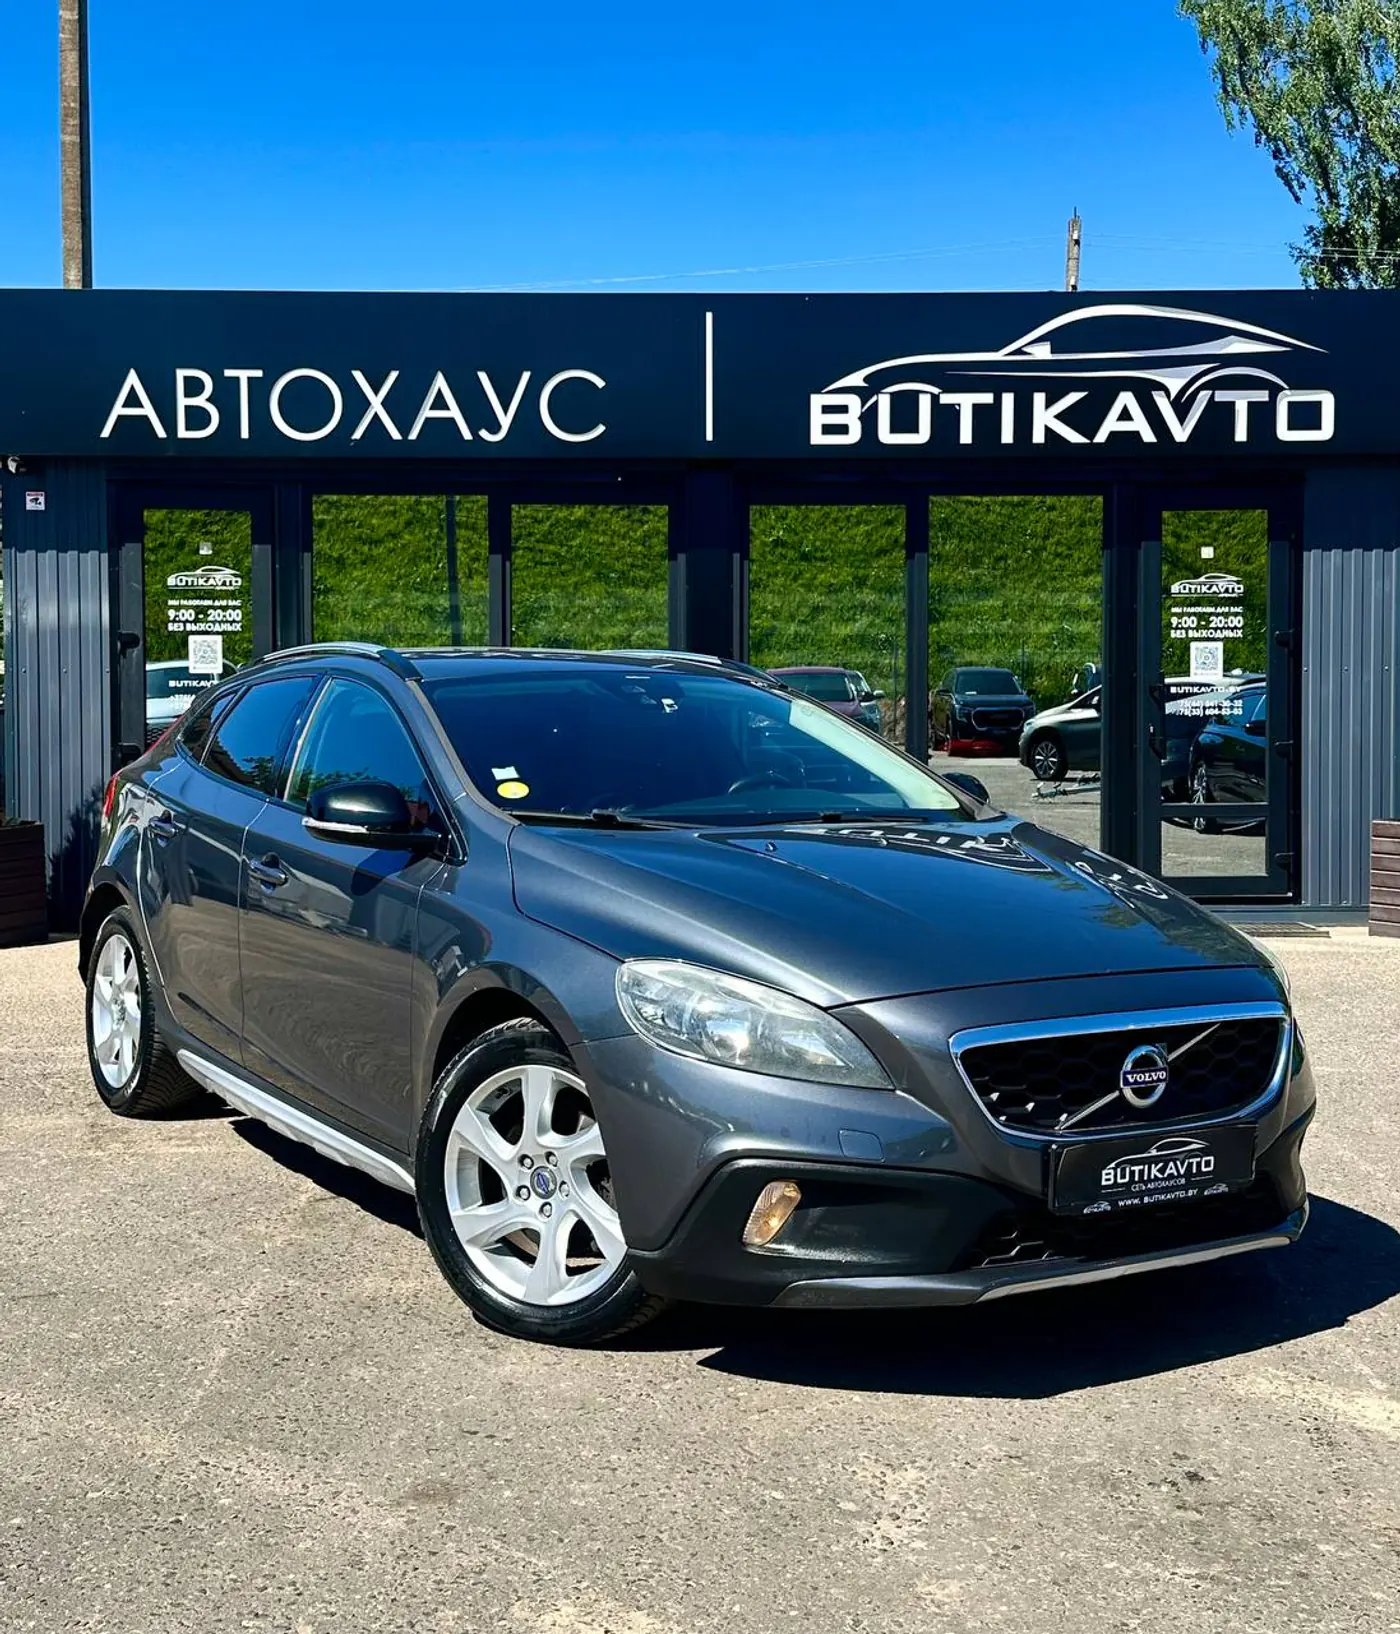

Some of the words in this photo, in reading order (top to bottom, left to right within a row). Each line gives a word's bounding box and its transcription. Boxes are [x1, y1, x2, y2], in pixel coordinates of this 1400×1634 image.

[100, 367, 605, 442] АВТОХАУС
[810, 388, 1335, 445] BUTIKAVTO
[167, 576, 242, 587] BUTIKAVTO
[1171, 584, 1244, 594] BUTIKAVTO
[167, 609, 195, 621] 9:00
[206, 609, 242, 621] 20:00
[167, 622, 184, 632] БЕЗ
[185, 622, 242, 632] ВЫХОДНЫХ
[1170, 616, 1197, 628] 9:00
[1209, 616, 1244, 628] 20:00
[1170, 629, 1186, 638] БЕЗ
[1188, 629, 1243, 639] ВЫХОДНЫХ
[1125, 1070, 1167, 1083] VOLVO
[1101, 1155, 1215, 1186] BUTIKAVTO
